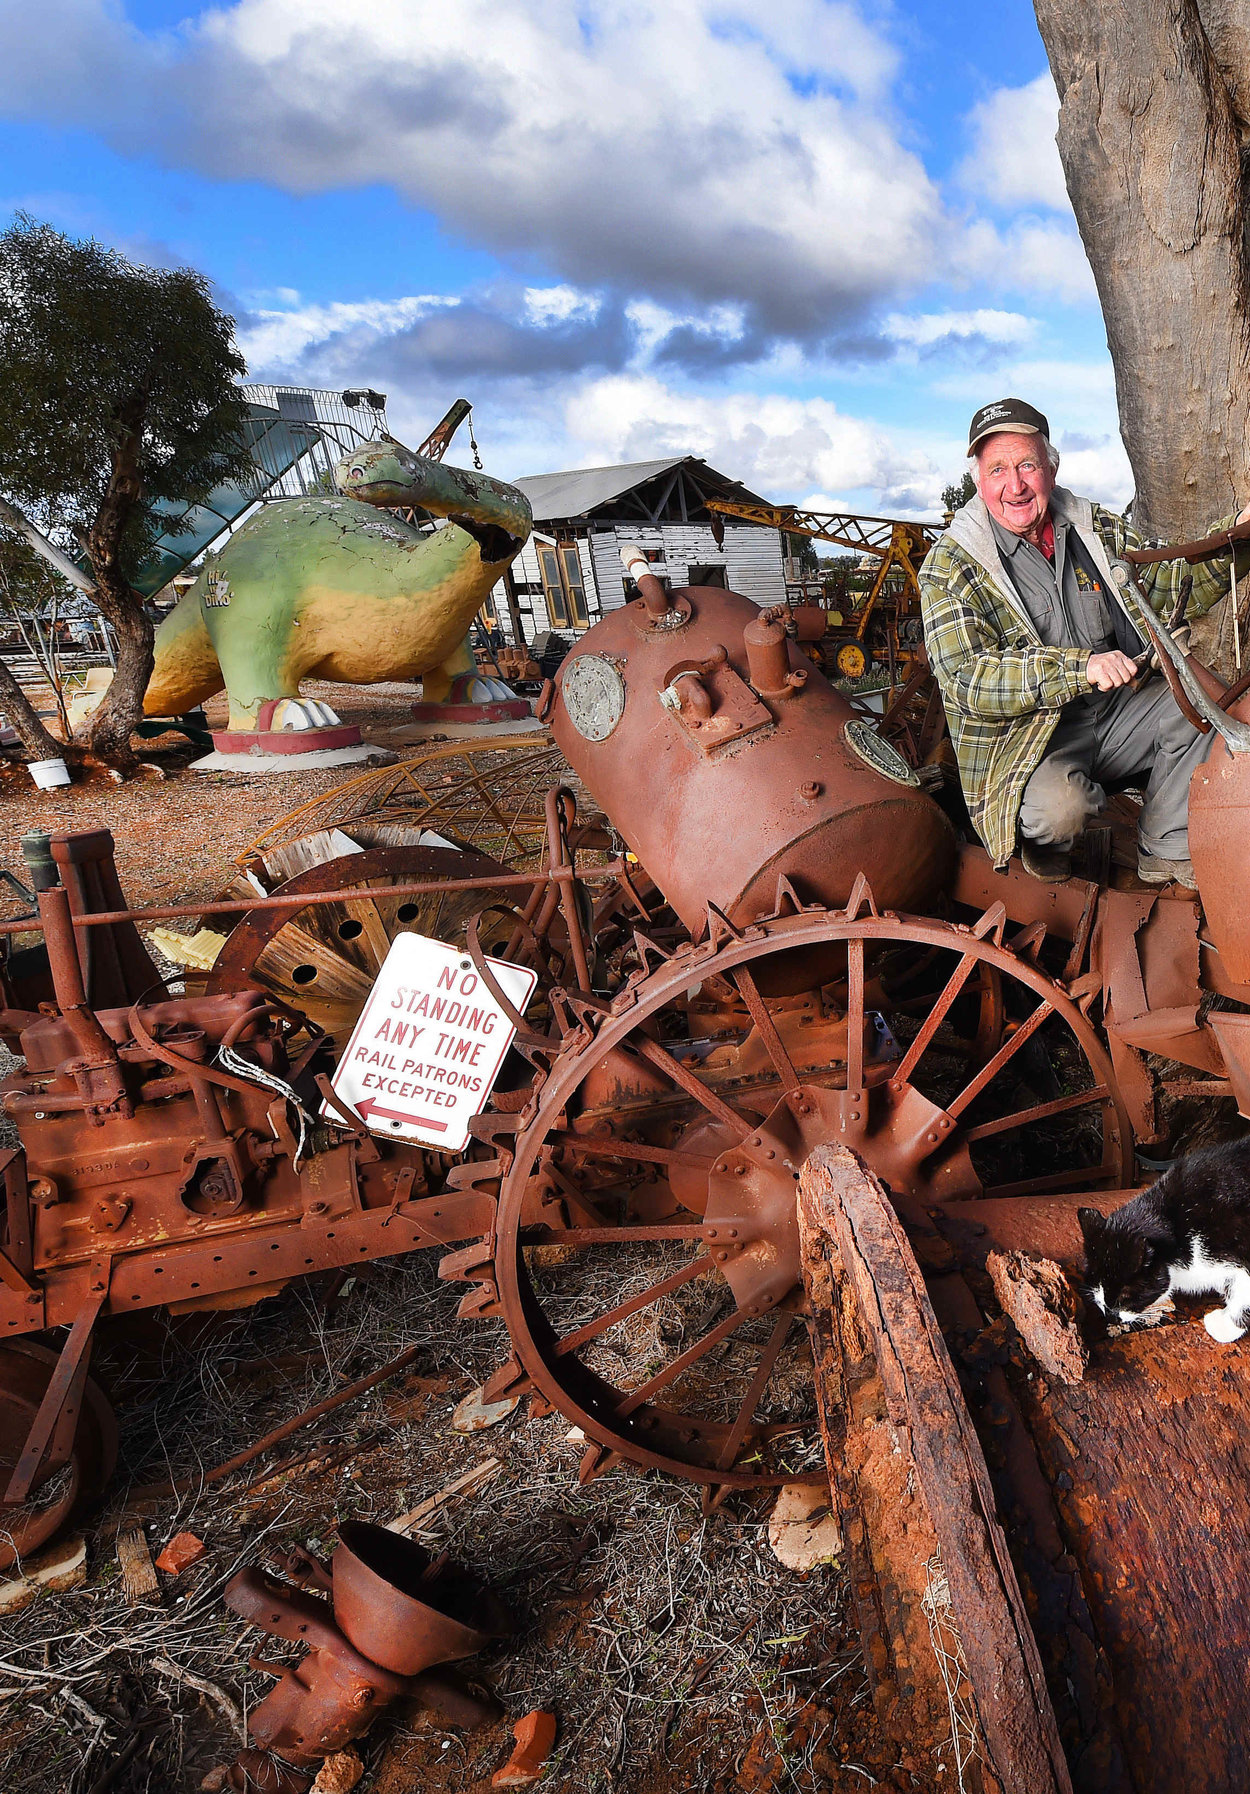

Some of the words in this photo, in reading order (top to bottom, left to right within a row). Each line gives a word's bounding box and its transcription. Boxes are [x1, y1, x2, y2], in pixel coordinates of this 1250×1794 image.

[436, 966, 478, 996] NO
[390, 986, 498, 1035] STANDING
[374, 1018, 425, 1049] ANY
[434, 1032, 486, 1067] TIME
[354, 1047, 396, 1070] RAIL
[401, 1059, 482, 1092] PATRONS
[361, 1073, 457, 1108] EXCEPTED
